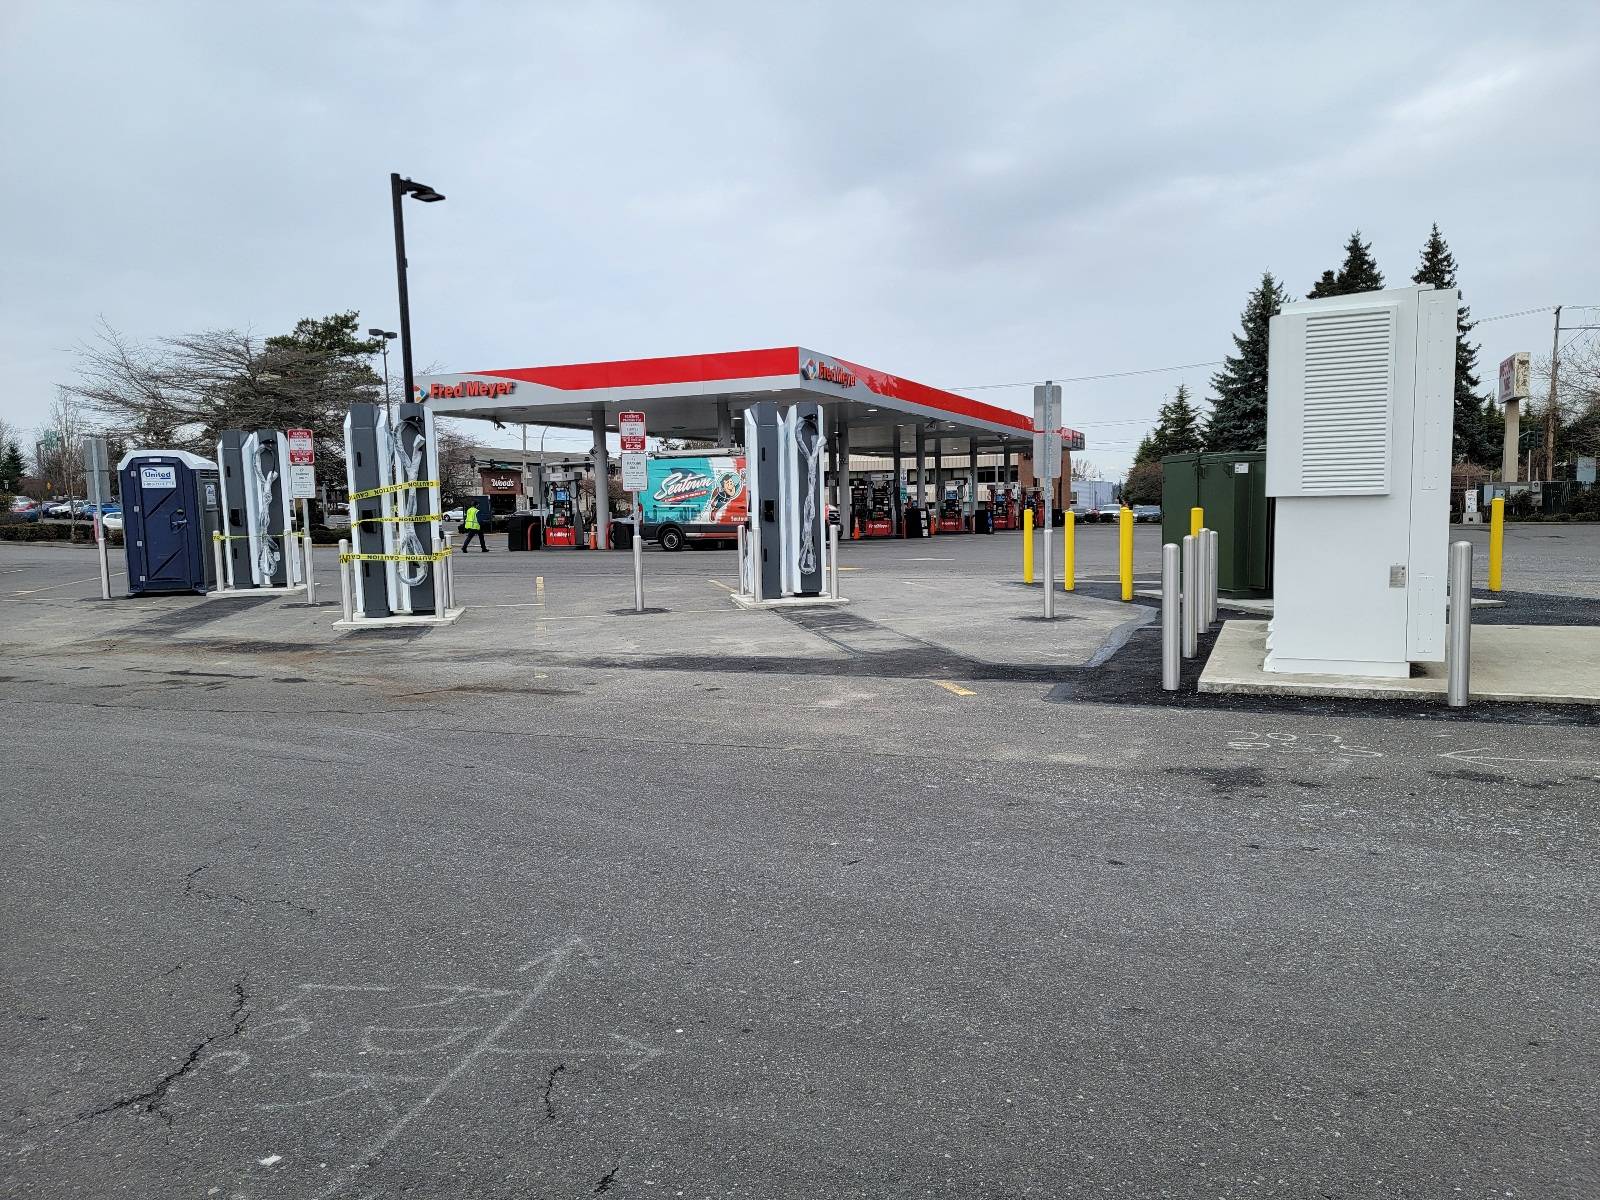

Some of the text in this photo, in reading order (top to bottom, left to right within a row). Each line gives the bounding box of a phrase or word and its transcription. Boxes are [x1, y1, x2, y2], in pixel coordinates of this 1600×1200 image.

[430, 380, 516, 399] Fred Meyer
[407, 480, 434, 488] CAUTION
[491, 478, 515, 487] Woods
[653, 472, 714, 500] Seatown
[373, 484, 403, 496] CAUTION
